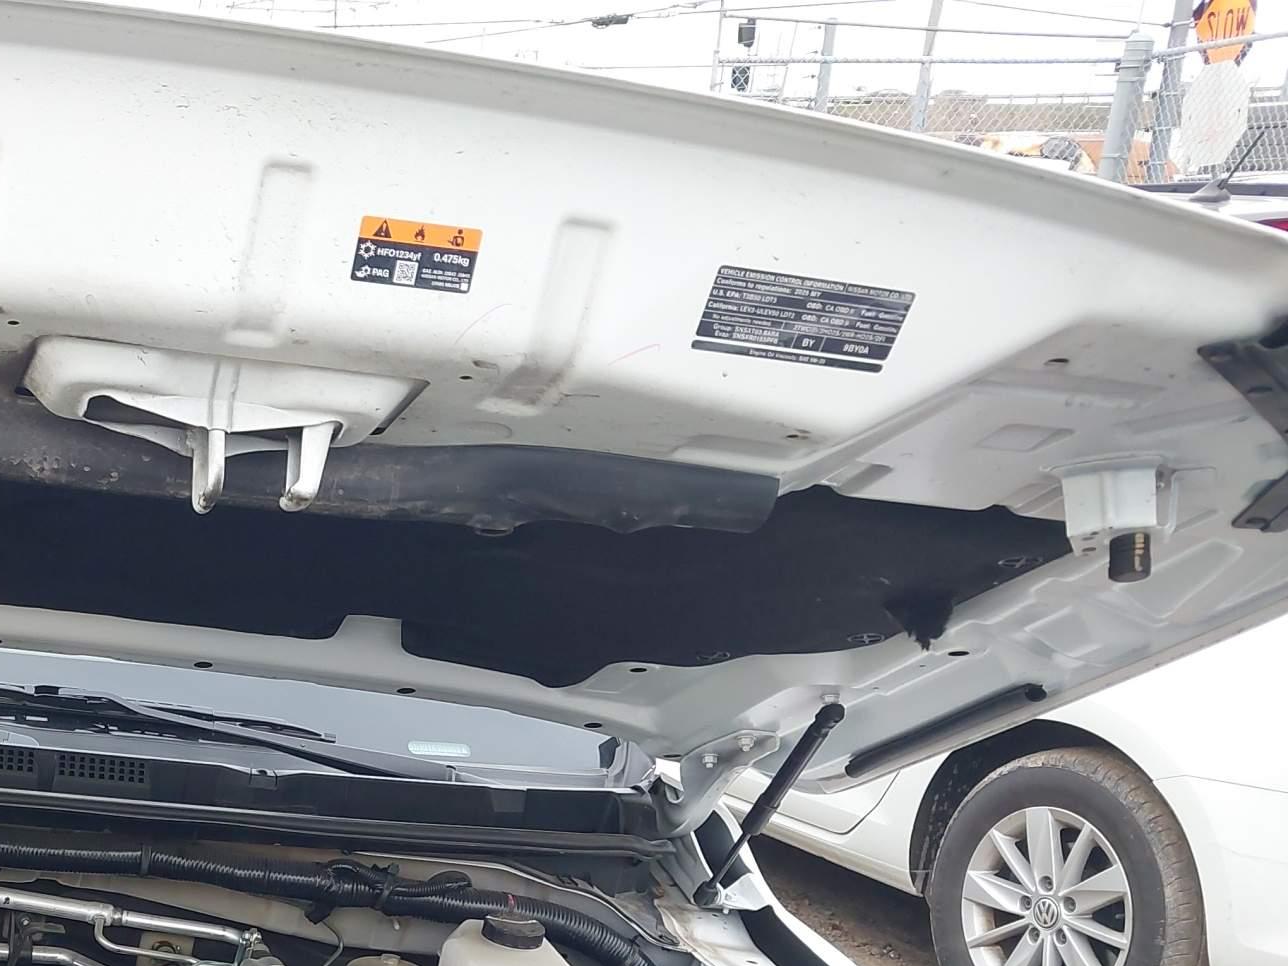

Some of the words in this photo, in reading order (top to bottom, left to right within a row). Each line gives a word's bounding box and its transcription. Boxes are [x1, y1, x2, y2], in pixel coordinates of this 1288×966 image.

[377, 247, 422, 261] HFO1234yf
[434, 252, 470, 267] 0.475kg
[372, 267, 390, 278] PAG
[720, 268, 745, 277] VEHICLE
[745, 270, 776, 281] EMISSION
[775, 275, 802, 286] CONTROL
[803, 279, 844, 291] INFORMATION
[716, 277, 746, 287] Conforms
[754, 283, 792, 294] regulations:
[712, 288, 724, 296] U.S.
[708, 301, 738, 311] California:
[806, 302, 822, 310] OBD:
[835, 306, 849, 314] OBD
[801, 314, 817, 322] OBD:
[830, 317, 844, 325] OBD
[801, 338, 816, 348] BY
